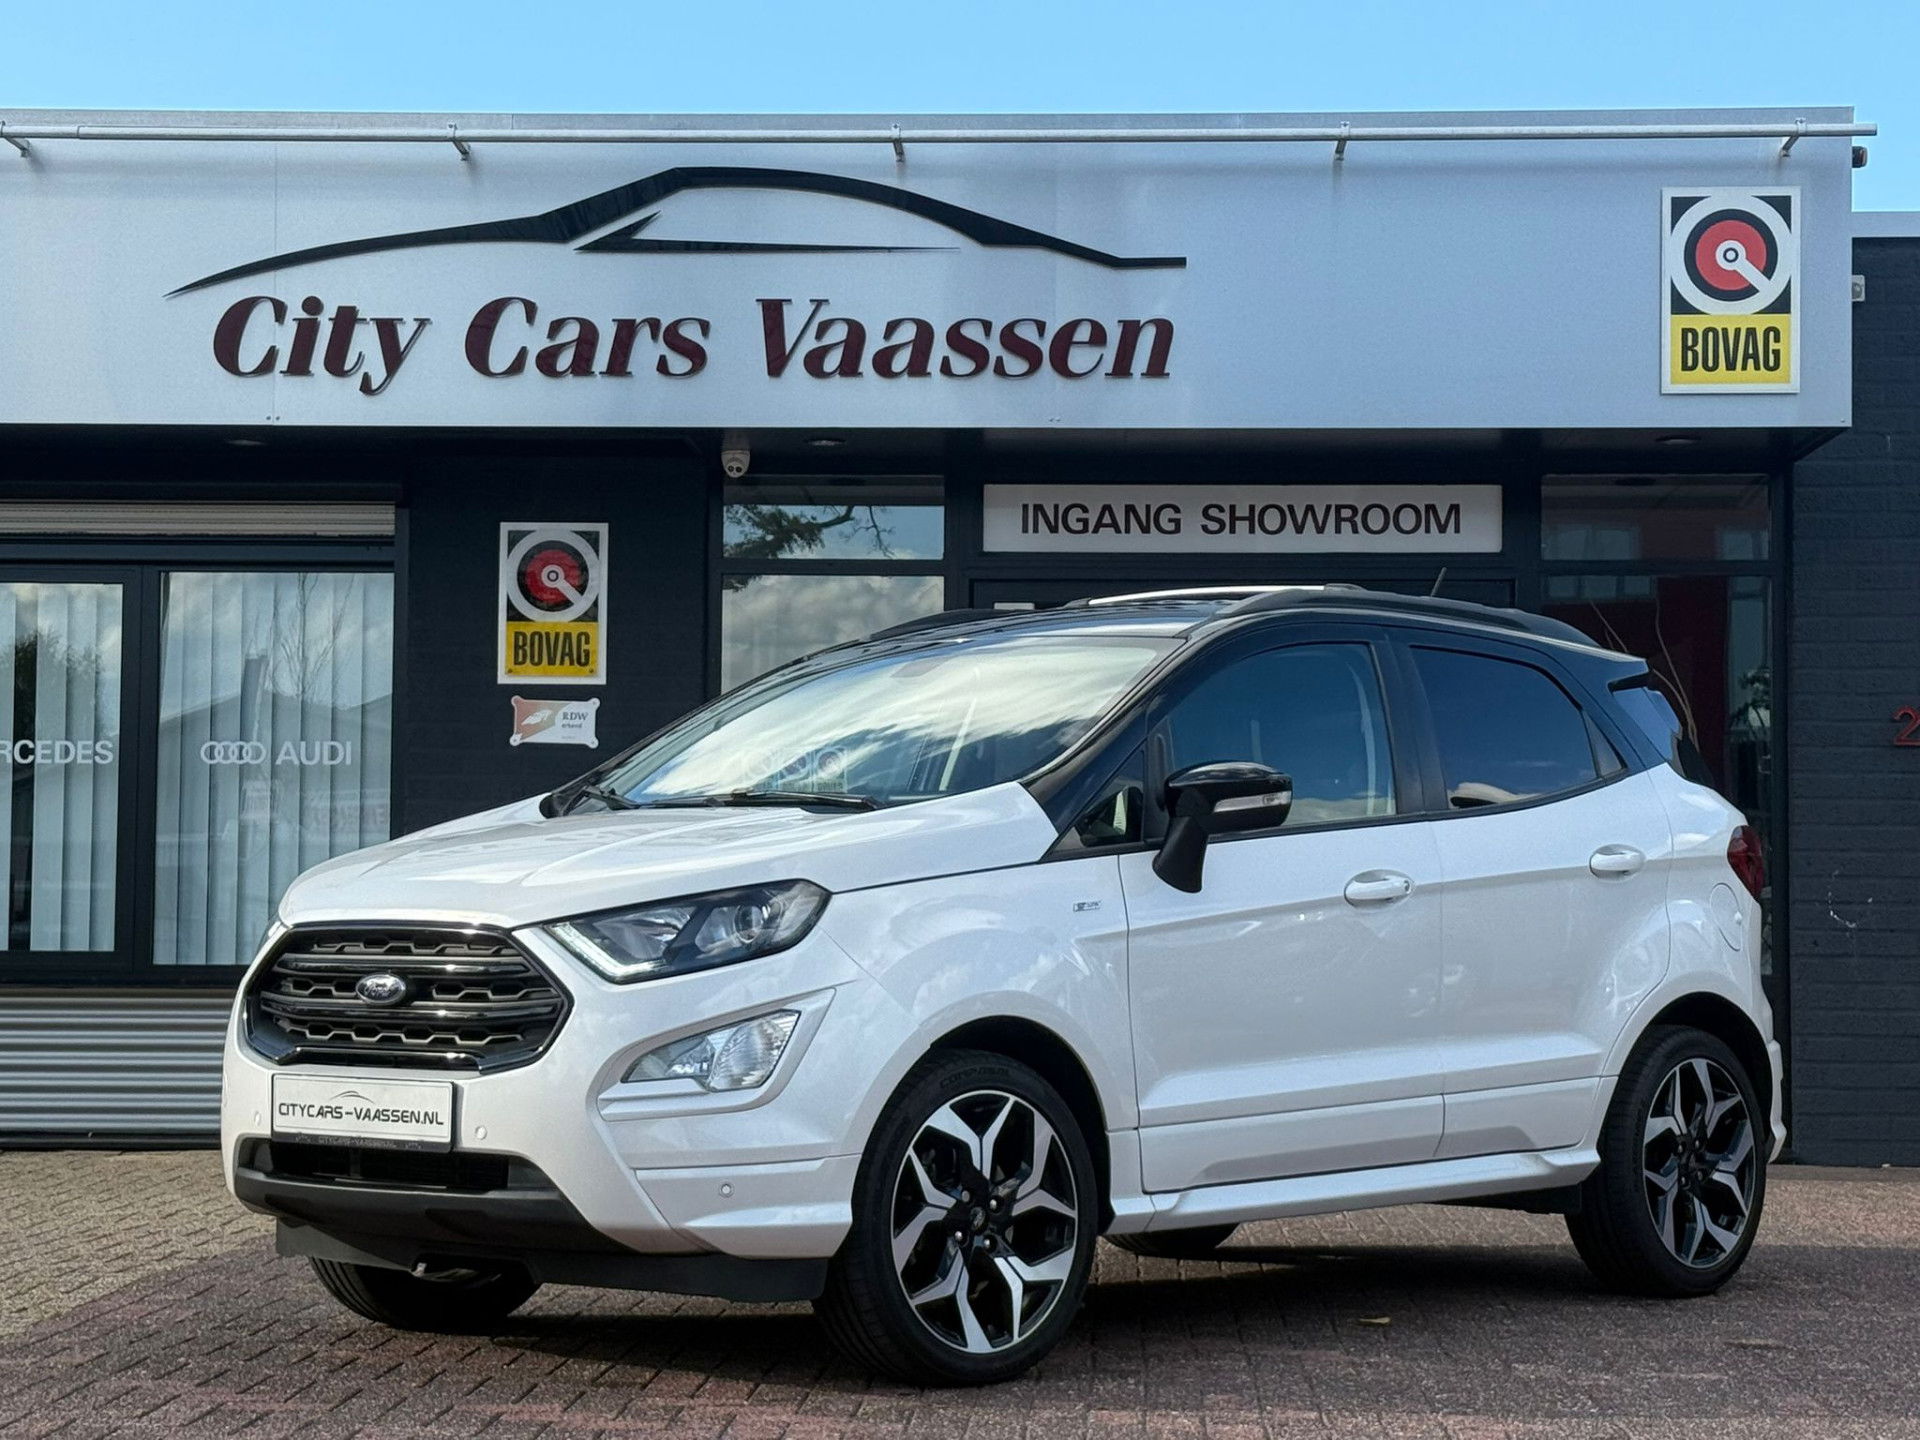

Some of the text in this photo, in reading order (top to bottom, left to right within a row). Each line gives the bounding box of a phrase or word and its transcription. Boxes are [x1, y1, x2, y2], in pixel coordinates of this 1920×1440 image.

[213, 296, 1175, 395] City Cars Vaassen
[1681, 326, 1781, 372] BOVAG
[1021, 503, 1461, 535] INGANG SHOWROOM
[513, 631, 591, 667] BOVAG
[562, 711, 588, 720] RDW
[275, 741, 352, 765] AUDI
[278, 1102, 444, 1126] CITYCARS-VAASSEN.NL
